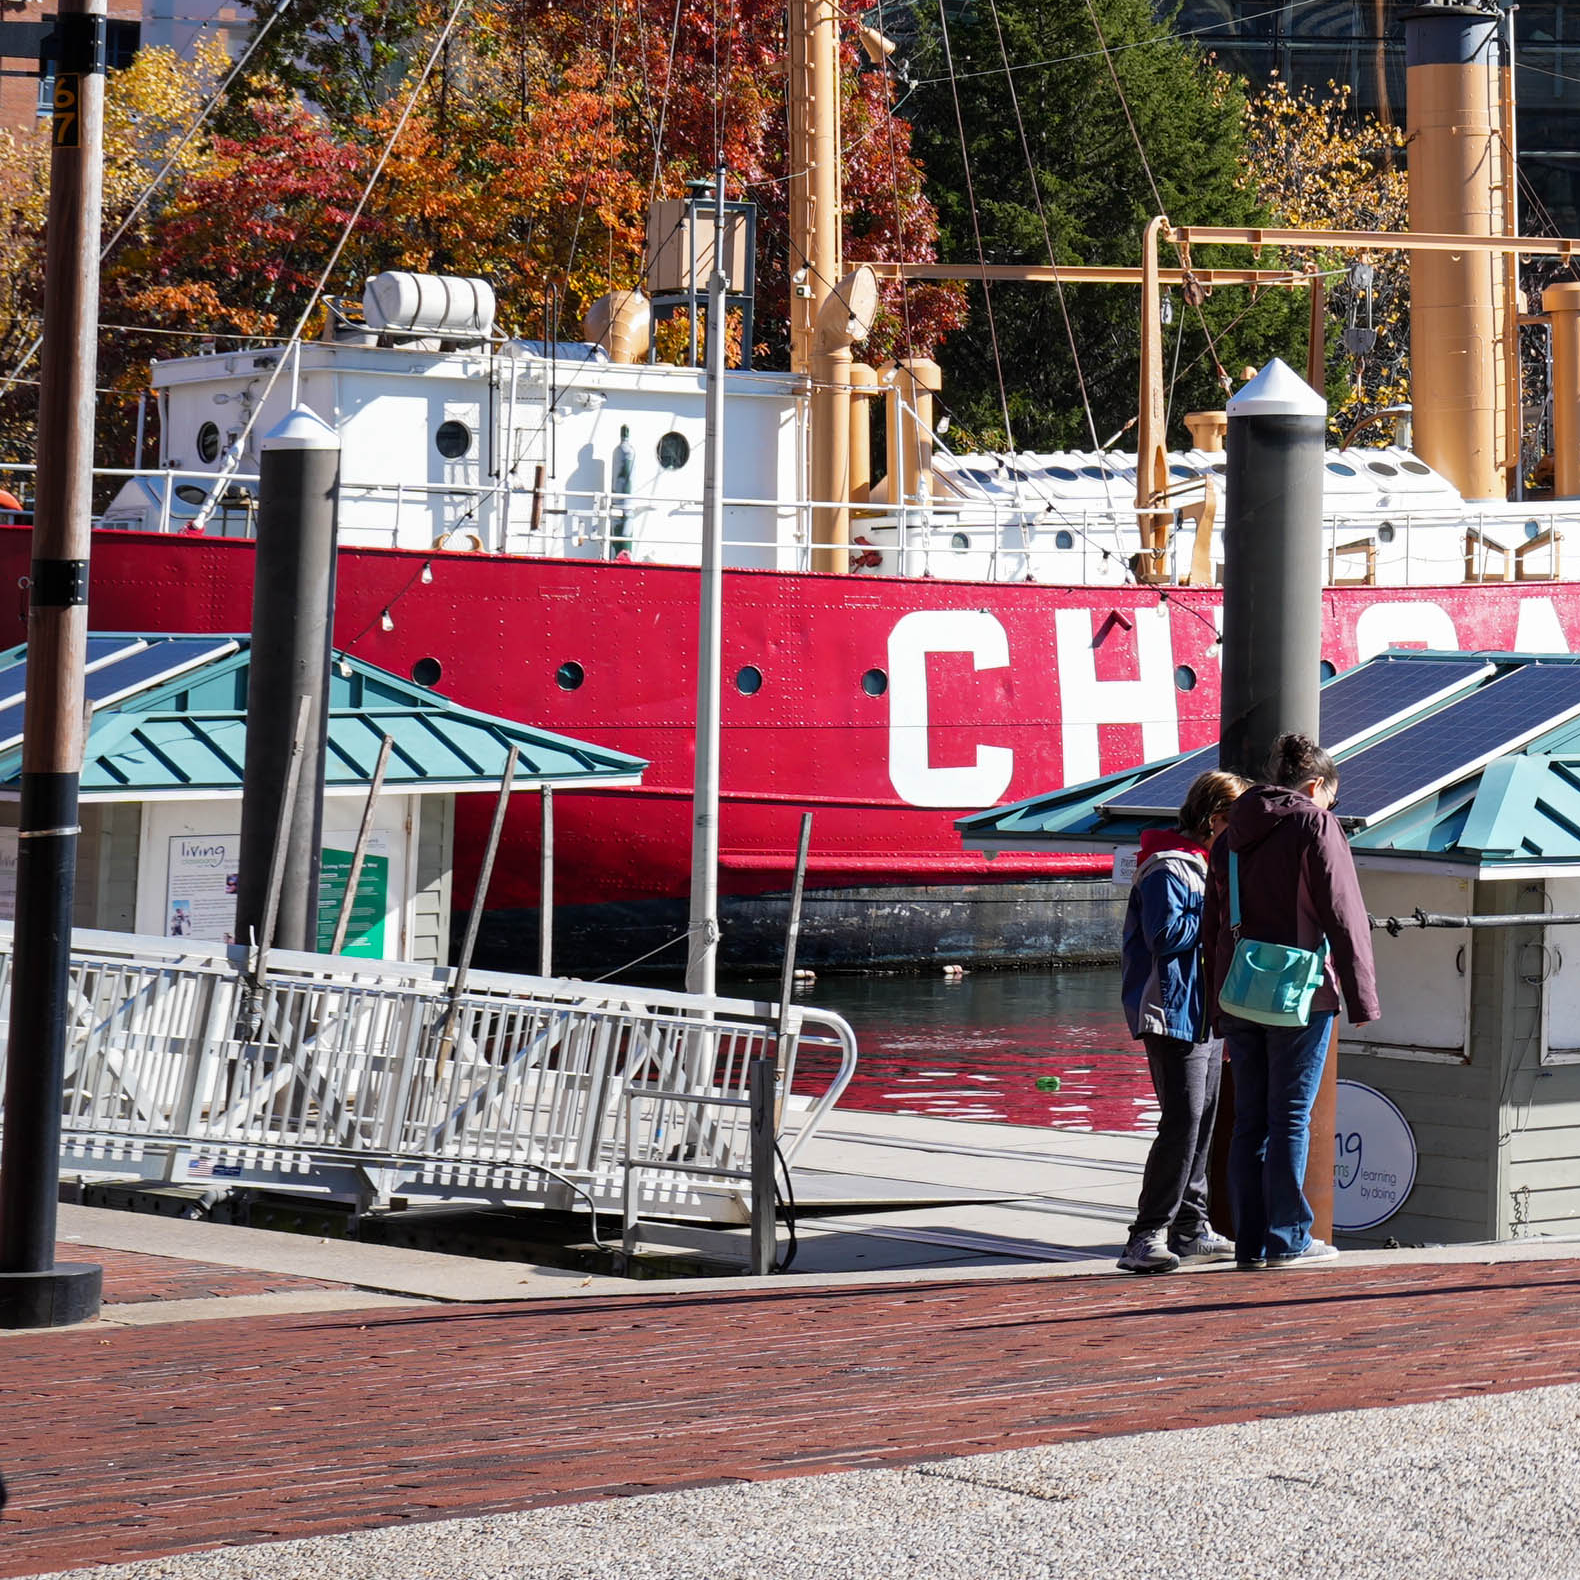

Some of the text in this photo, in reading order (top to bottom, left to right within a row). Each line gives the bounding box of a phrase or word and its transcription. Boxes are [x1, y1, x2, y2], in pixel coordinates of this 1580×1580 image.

[182, 842, 225, 868] living
[1360, 1167, 1397, 1187] learning
[1360, 1183, 1397, 1203] by doing
